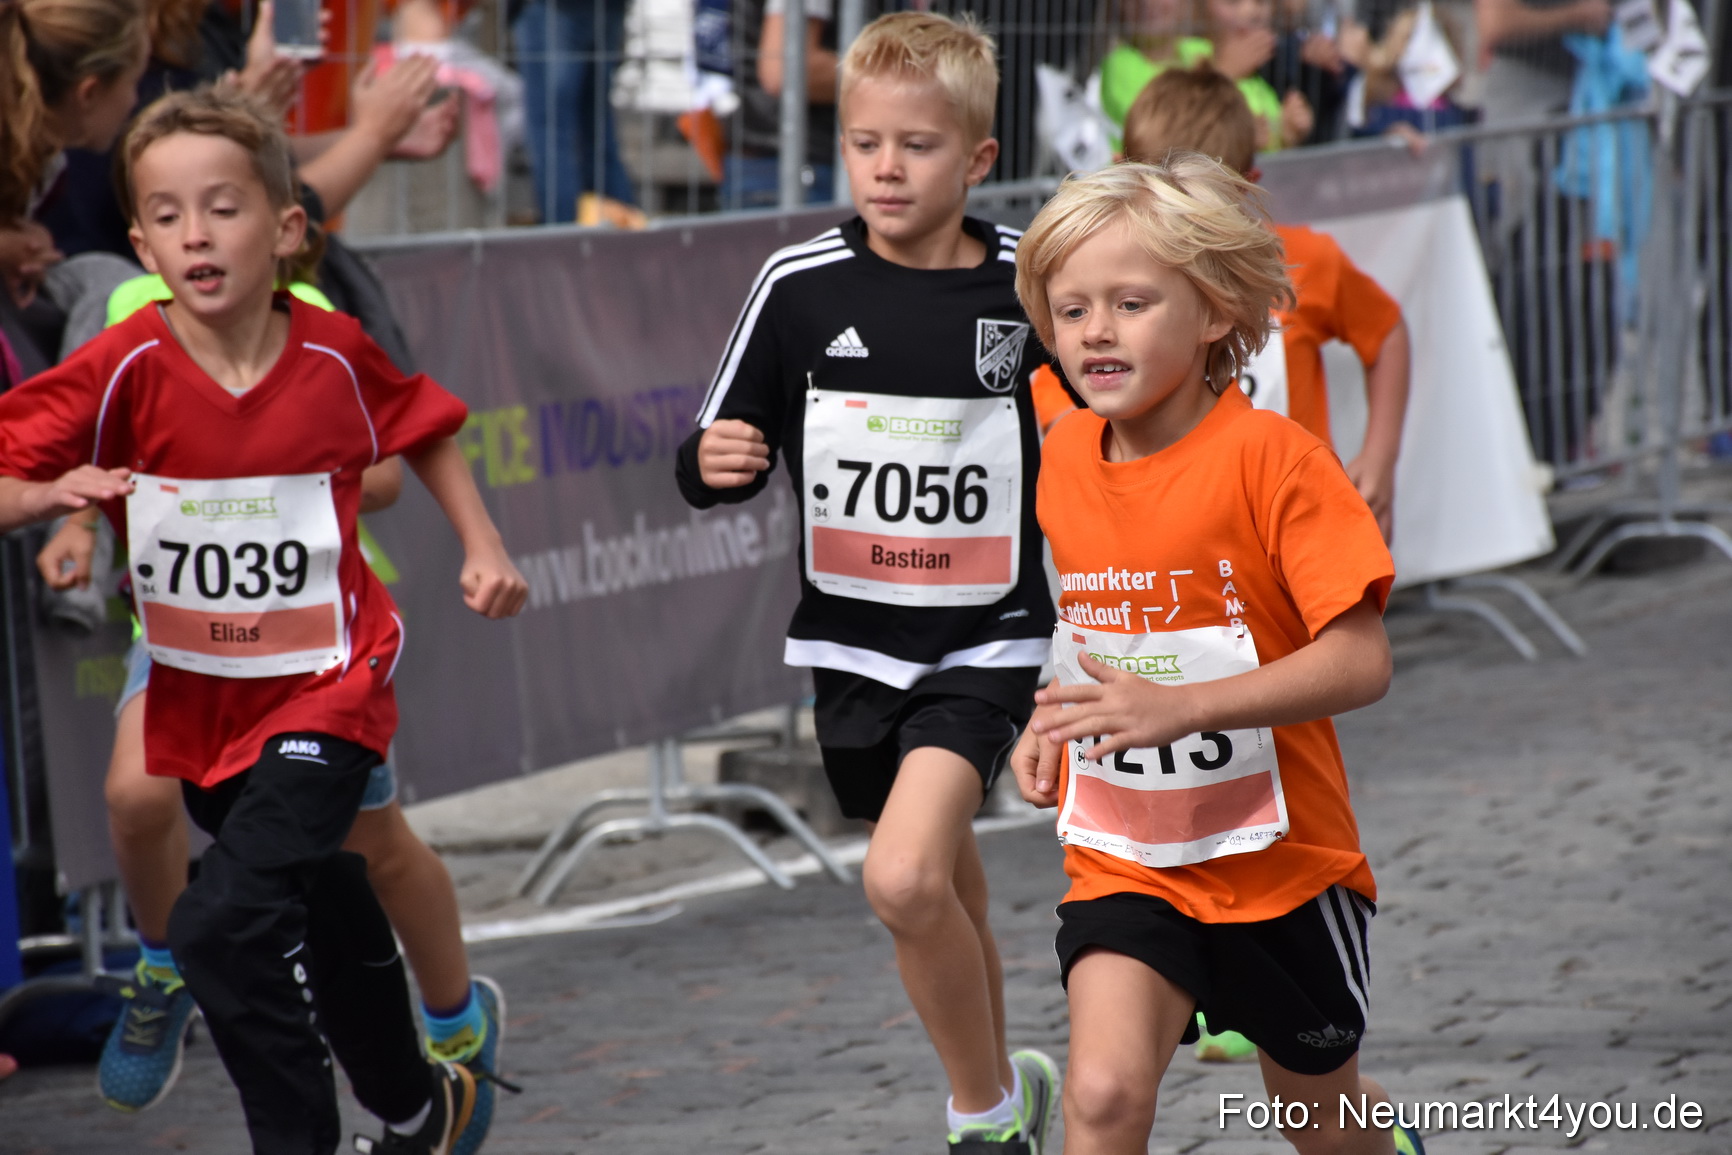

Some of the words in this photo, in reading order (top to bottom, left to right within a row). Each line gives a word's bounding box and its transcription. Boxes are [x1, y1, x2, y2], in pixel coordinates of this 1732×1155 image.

[825, 346, 869, 358] adidas
[889, 417, 962, 437] BOCK
[837, 459, 989, 525] 7056
[202, 497, 277, 517] BOCK
[870, 544, 951, 570] Bastian
[158, 540, 310, 600] 7039
[210, 622, 261, 643] Elias
[1104, 654, 1183, 676] BOCK
[1155, 673, 1185, 683] concepts
[278, 740, 321, 756] JAKO
[1083, 836, 1110, 848] ALEX
[1296, 1030, 1357, 1049] adidas
